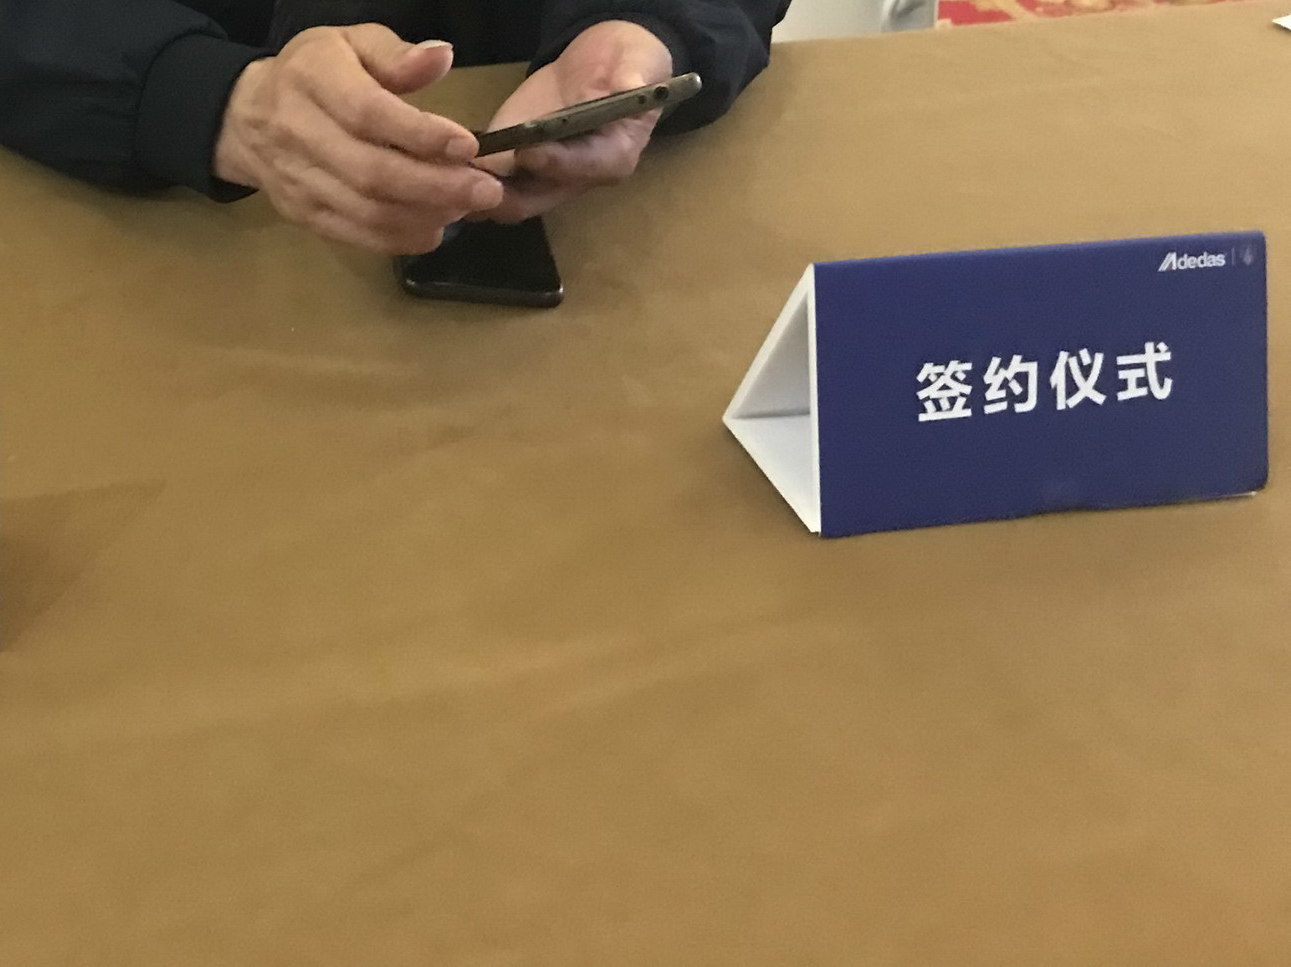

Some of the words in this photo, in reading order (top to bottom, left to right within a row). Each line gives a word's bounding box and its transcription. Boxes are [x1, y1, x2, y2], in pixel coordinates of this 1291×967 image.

[1158, 251, 1226, 272] Adedas
[915, 341, 1173, 423] 签约仪式
